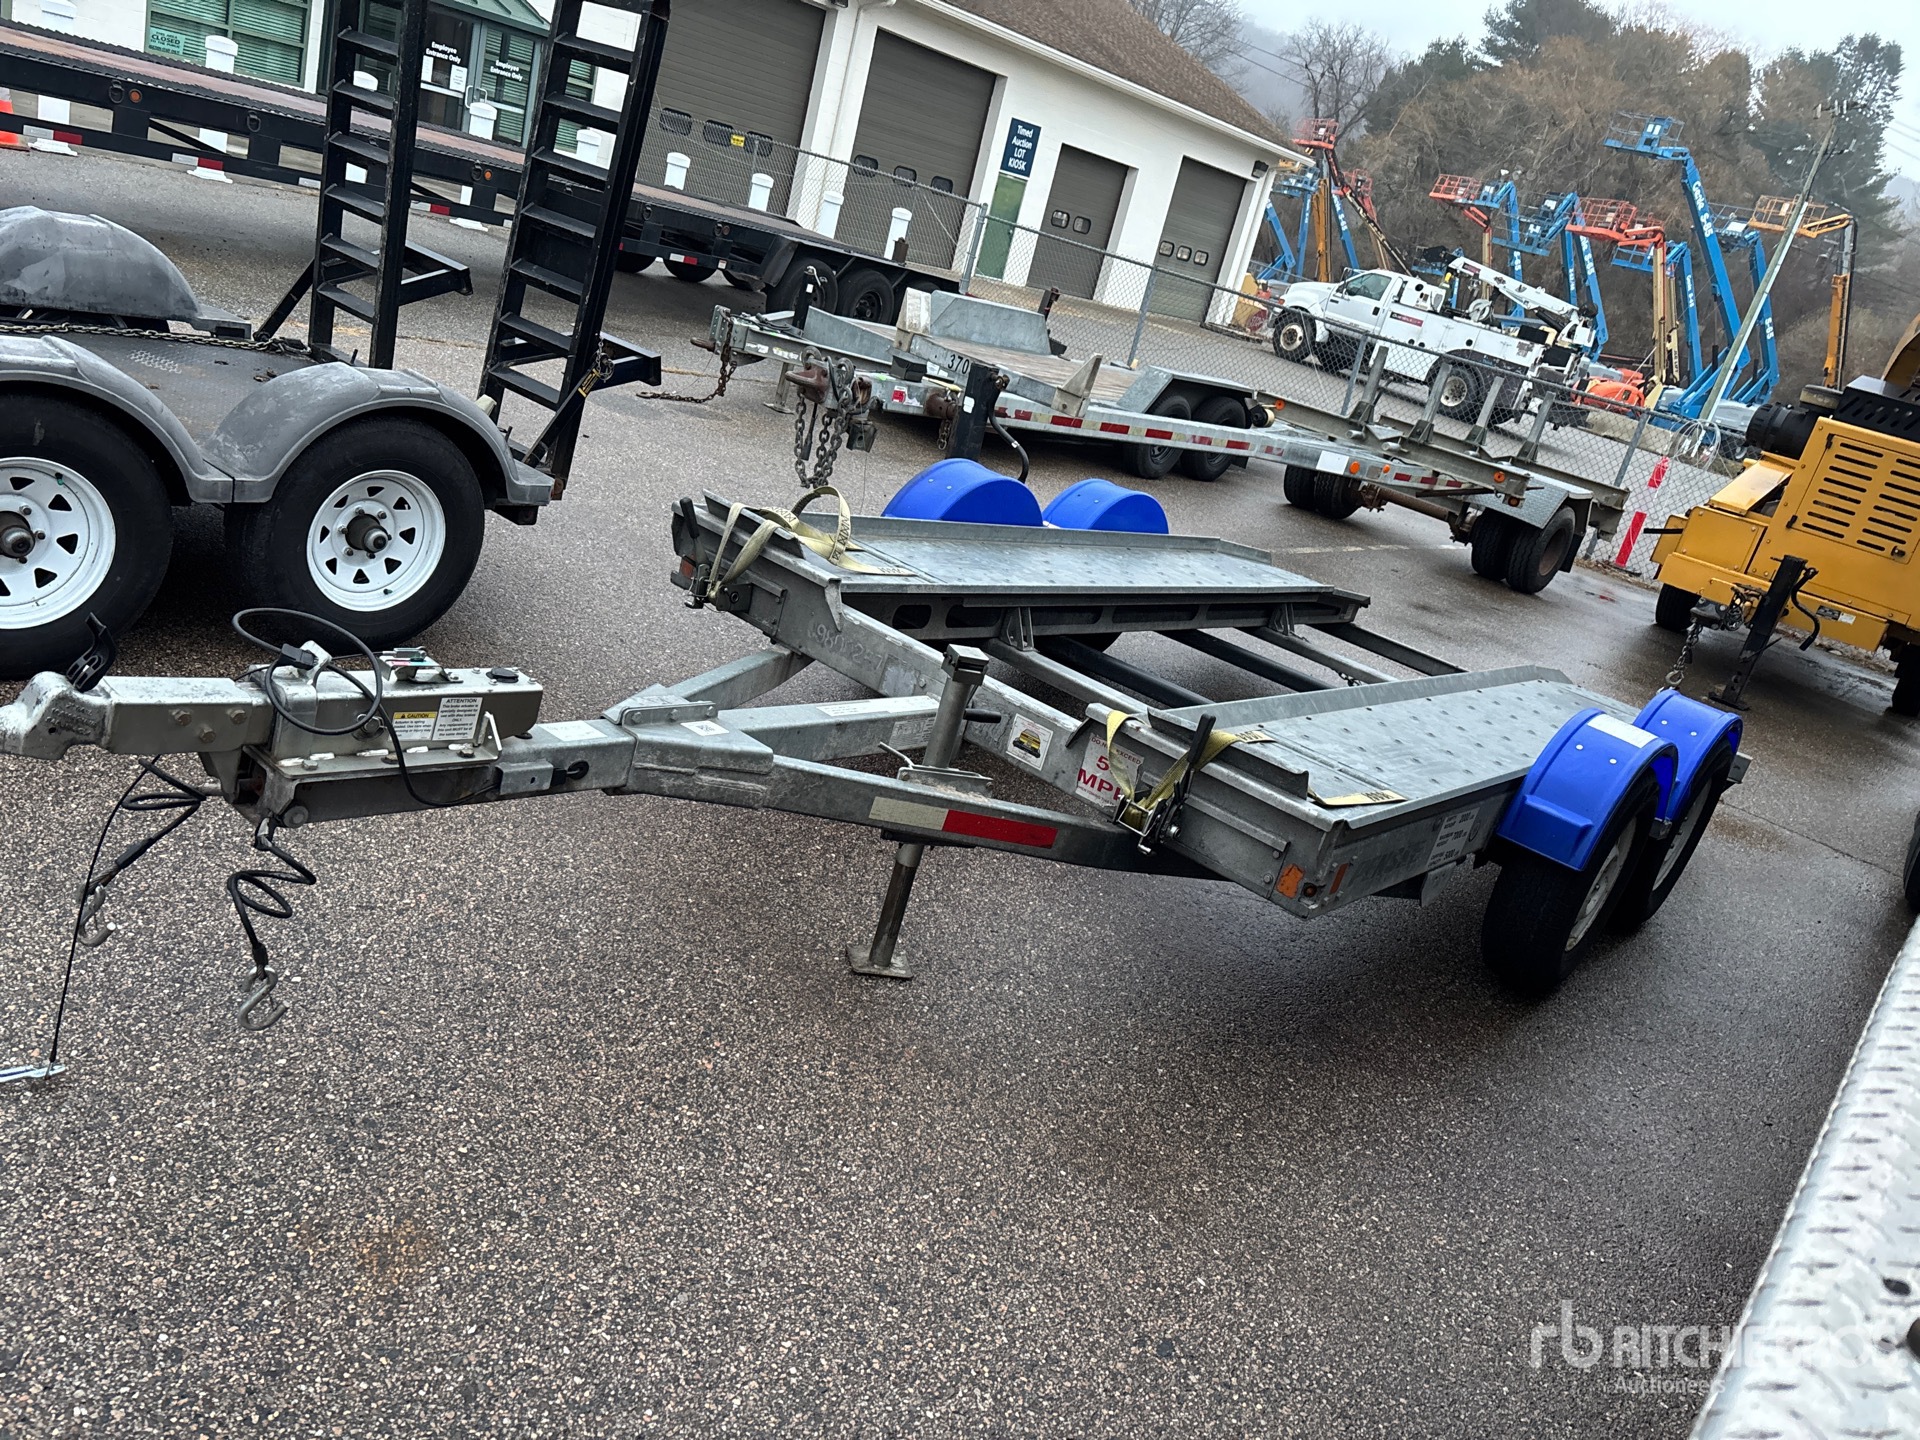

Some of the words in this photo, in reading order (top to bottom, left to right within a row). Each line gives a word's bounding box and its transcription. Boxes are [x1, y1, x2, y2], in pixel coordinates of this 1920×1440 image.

[151, 35, 180, 44] CLOSED
[432, 41, 457, 54] Employee
[426, 48, 449, 61] Entrance
[449, 54, 461, 64] Only
[495, 60, 520, 72] Employee
[490, 66, 511, 78] Entrance
[512, 72, 523, 81] Only
[1017, 125, 1033, 138] Timed
[1012, 136, 1032, 150] Auction
[1014, 148, 1026, 159] LOT
[1008, 157, 1026, 171] KIOSK
[1692, 180, 1704, 211] Genie
[1700, 212, 1714, 238] S-85
[948, 354, 969, 374] 370
[1096, 756, 1109, 771] 5
